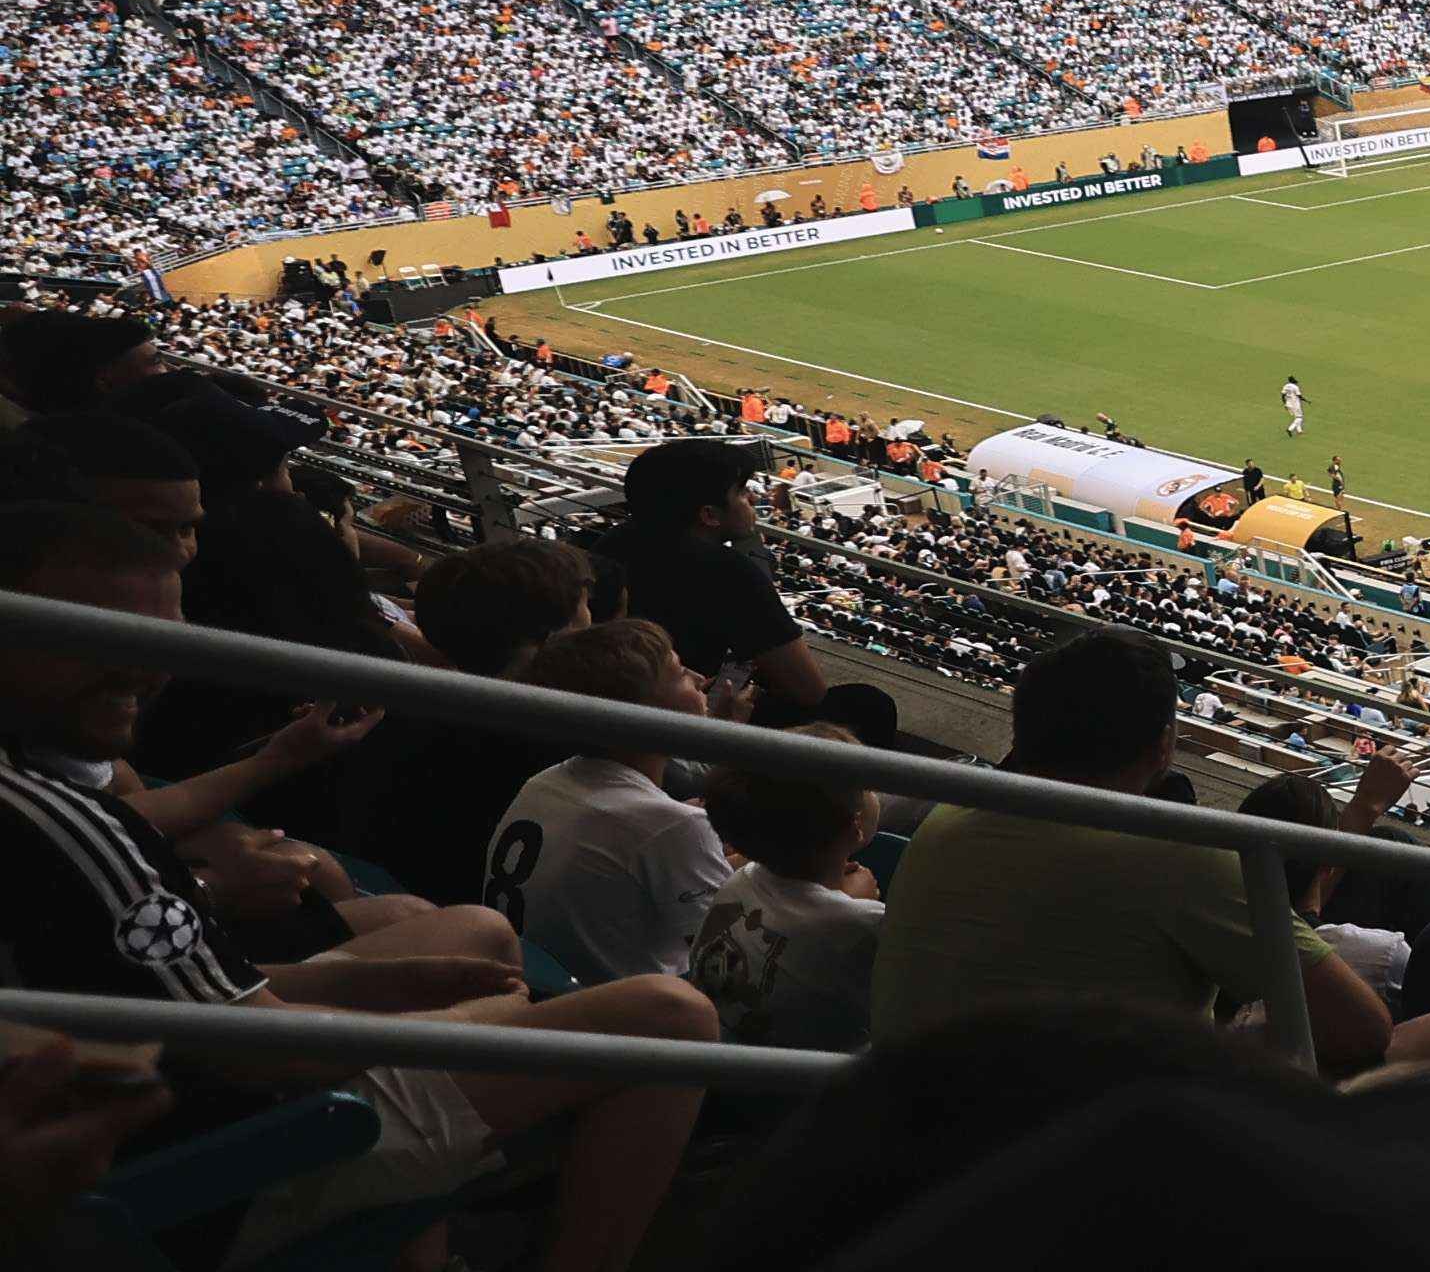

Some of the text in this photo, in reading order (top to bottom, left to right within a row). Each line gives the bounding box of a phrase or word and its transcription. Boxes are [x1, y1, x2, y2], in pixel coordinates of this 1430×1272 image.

[1310, 138, 1374, 160] INVESTED
[1380, 134, 1395, 148] IN
[1004, 173, 1162, 210] INVESTED IN BETTER
[612, 227, 820, 270] INVESTED IN BETTER
